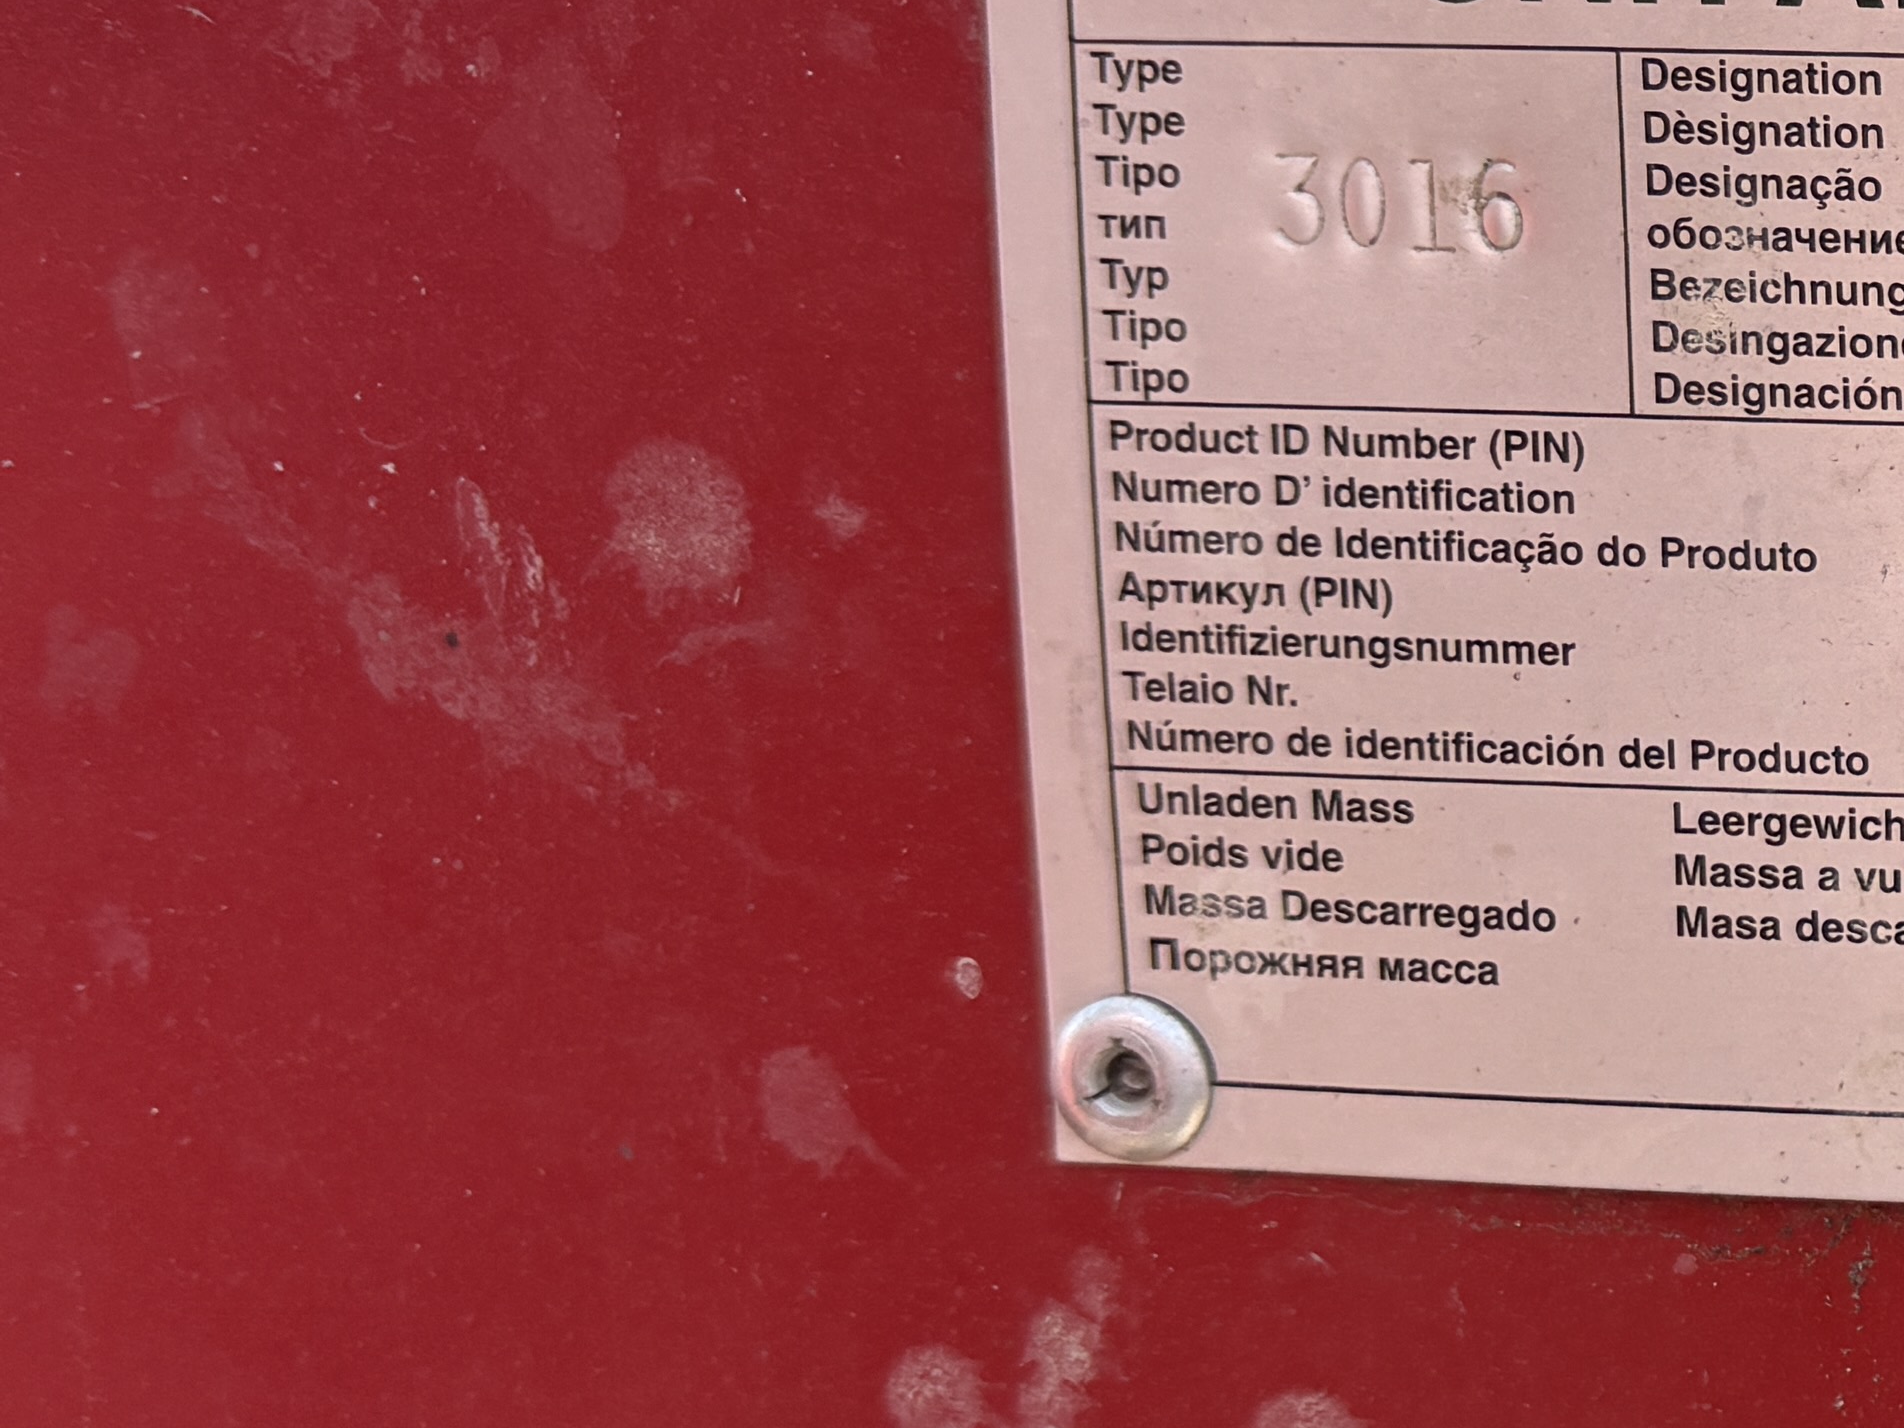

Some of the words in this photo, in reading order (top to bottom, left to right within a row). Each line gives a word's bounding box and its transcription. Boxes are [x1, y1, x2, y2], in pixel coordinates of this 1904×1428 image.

[1087, 49, 1184, 94] Type
[1640, 55, 1883, 104] Designation
[1090, 101, 1187, 146] Type
[1642, 108, 1885, 157] Dèsignation
[1092, 153, 1182, 198] Tipo
[1644, 161, 1883, 212] Designação
[1095, 212, 1168, 241] тип
[1274, 153, 1525, 253] 3016
[1097, 256, 1170, 301] Typ
[1099, 307, 1188, 352] Tipo
[1102, 358, 1191, 400] Tipo
[1652, 370, 1904, 418] Designación
[1107, 418, 1261, 456] Product
[1269, 421, 1311, 457] ID
[1321, 423, 1478, 462] Number
[1487, 427, 1586, 474] (PIN)
[1109, 469, 1262, 507] Numero
[1321, 474, 1576, 516] identification
[1112, 518, 1265, 557] Número
[1274, 524, 1323, 559] de
[1333, 525, 1585, 575] Identificação
[1595, 533, 1648, 569] do
[1659, 535, 1819, 574] Produto
[1116, 569, 1287, 616] Артикул
[1297, 574, 1394, 621] (PIN)
[1118, 619, 1578, 670] Identifizierungsnummer
[1119, 669, 1235, 706] Telaio
[1245, 673, 1299, 708] Nr.
[1125, 718, 1275, 757] Número
[1285, 724, 1333, 759] de
[1343, 725, 1606, 769] identificación
[1617, 736, 1677, 771] del
[1689, 737, 1871, 778] Producto
[1135, 780, 1299, 821] Unladen
[1309, 787, 1416, 826] Mass
[1138, 831, 1250, 870] Poids
[1259, 837, 1345, 876] vide
[1673, 852, 1806, 892] Massa
[1816, 865, 1842, 893] a
[1141, 882, 1269, 921] Massa
[1279, 887, 1558, 940] Descarregado
[1675, 903, 1783, 943] Masa
[1147, 935, 1365, 983] Порожняя
[1377, 955, 1501, 987] масса
